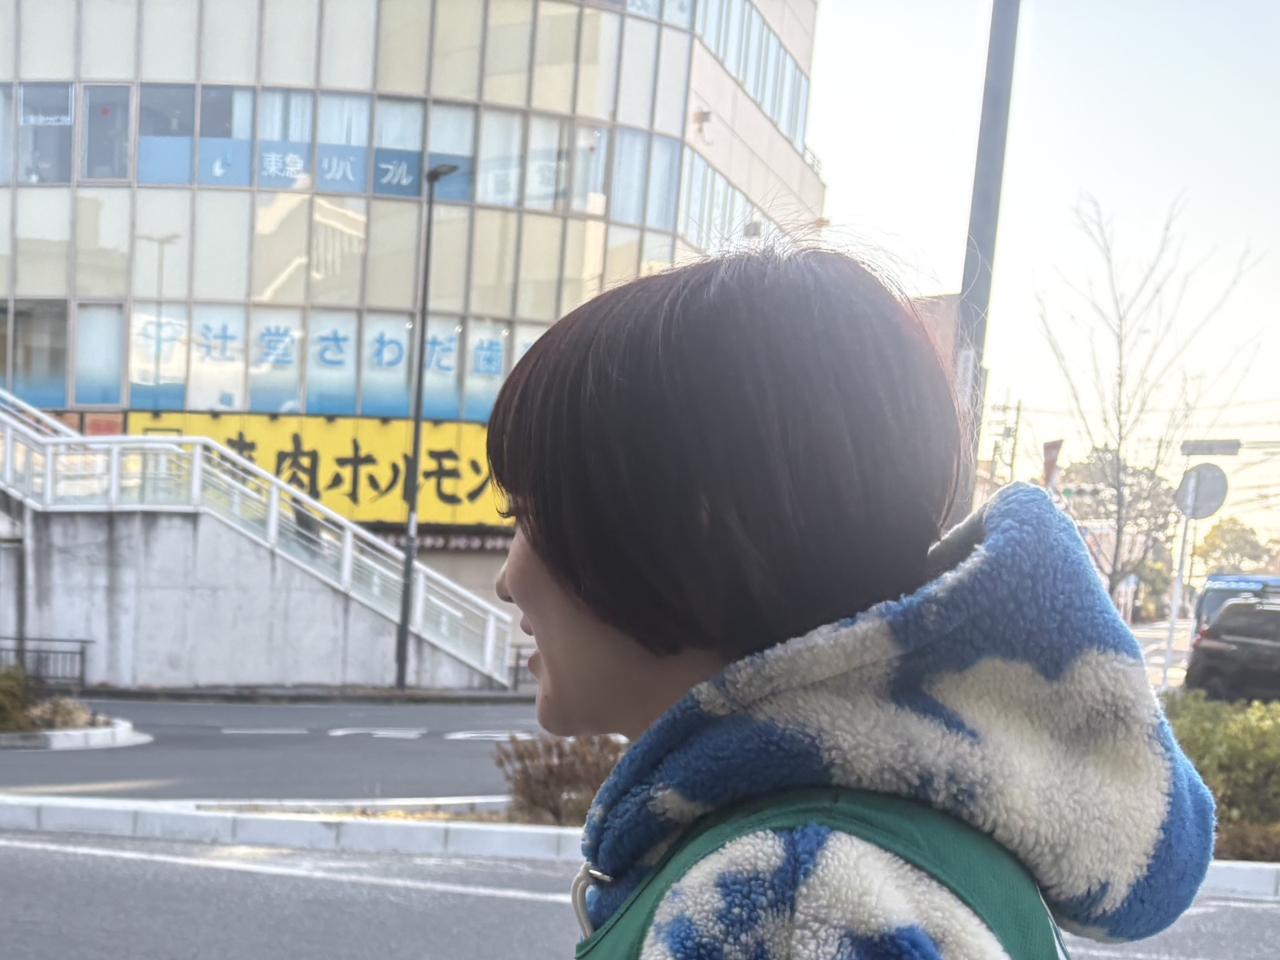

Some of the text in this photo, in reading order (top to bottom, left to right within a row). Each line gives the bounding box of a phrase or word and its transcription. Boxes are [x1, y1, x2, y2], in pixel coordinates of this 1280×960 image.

[200, 322, 532, 378] 辻堂さわだ歯
